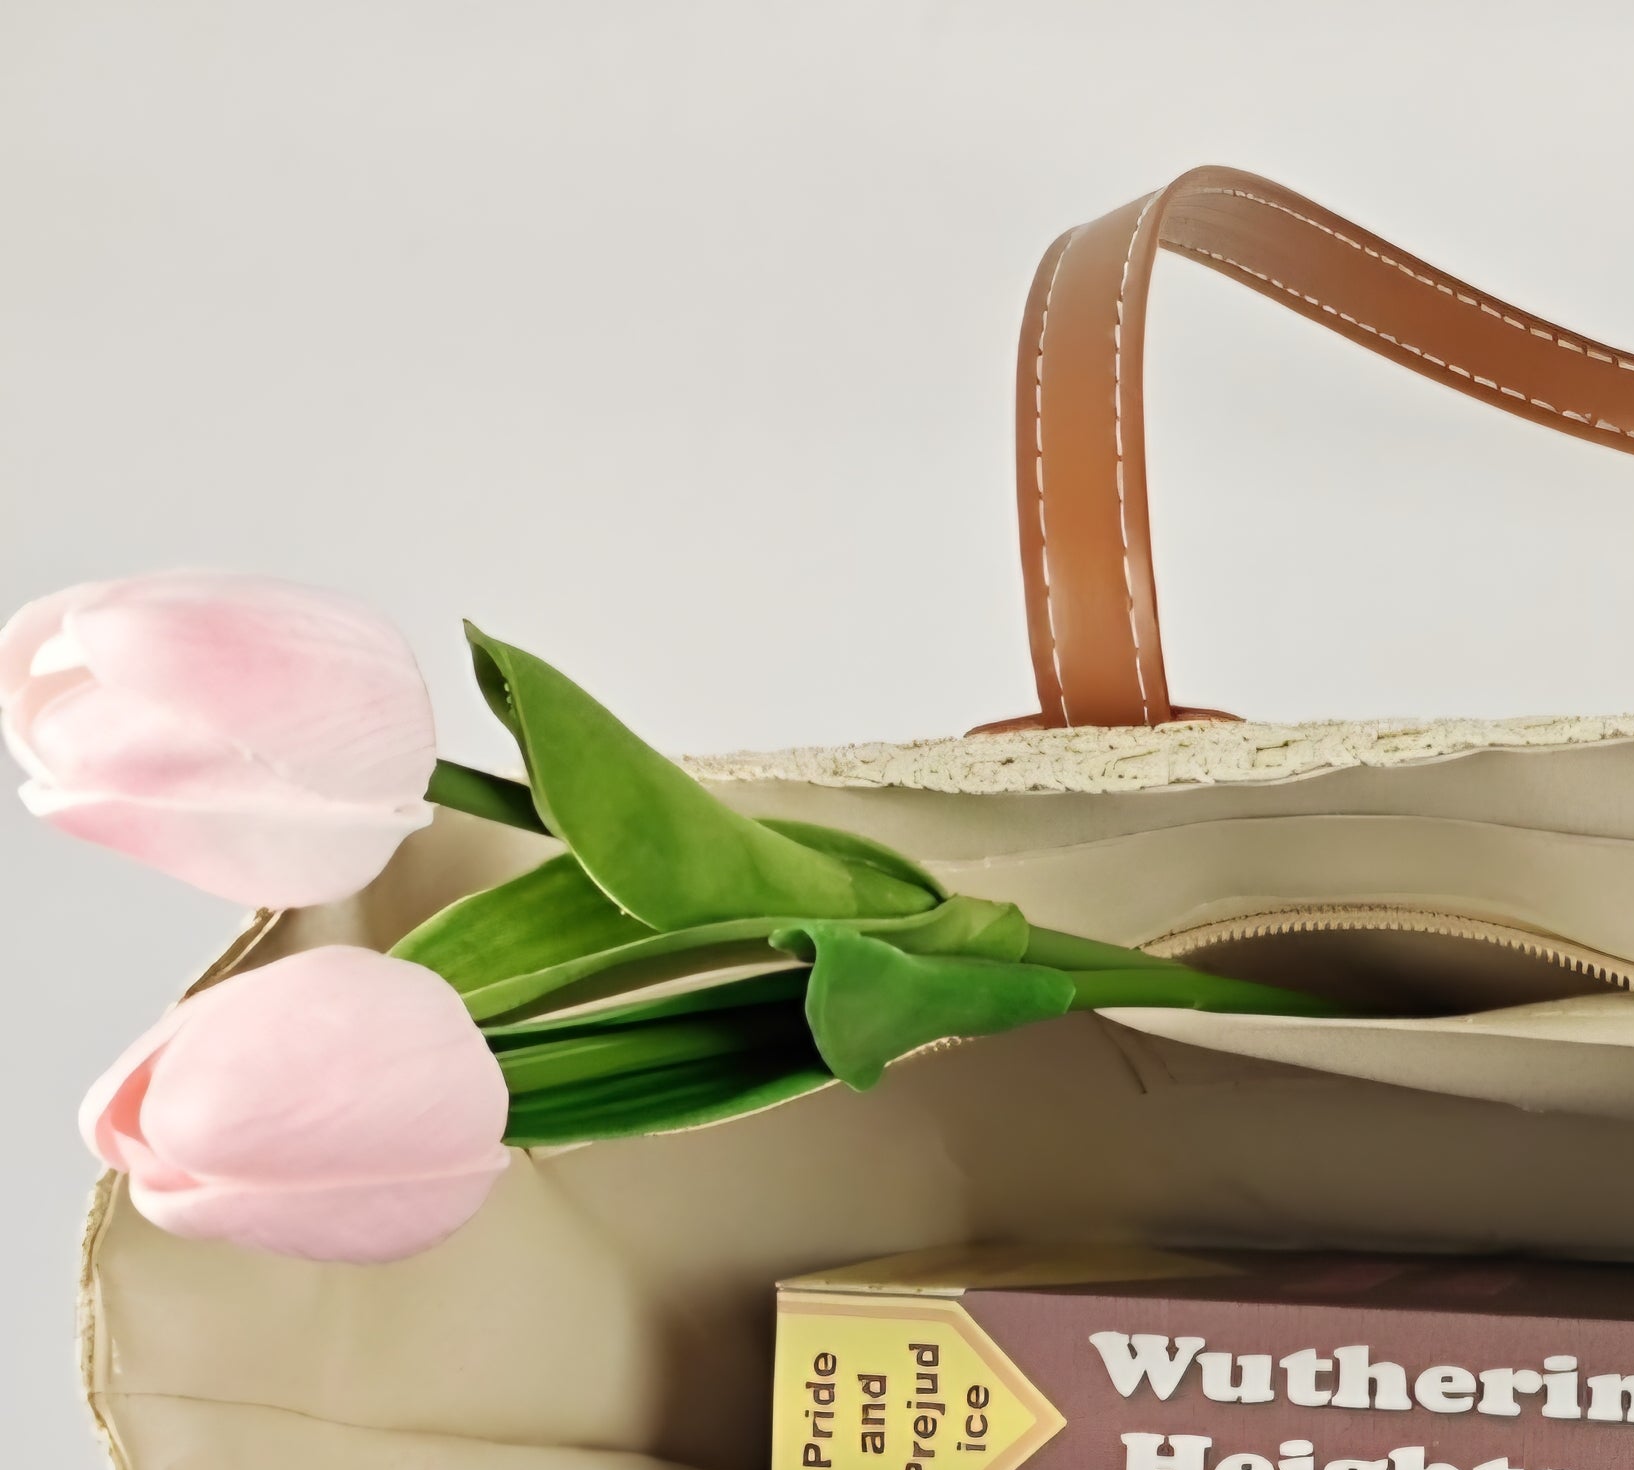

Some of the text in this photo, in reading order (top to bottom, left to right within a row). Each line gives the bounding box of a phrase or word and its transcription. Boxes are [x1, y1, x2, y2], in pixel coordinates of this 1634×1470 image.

[802, 1351, 837, 1469] Pride
[856, 1372, 888, 1455] and
[956, 1383, 991, 1454] ice
